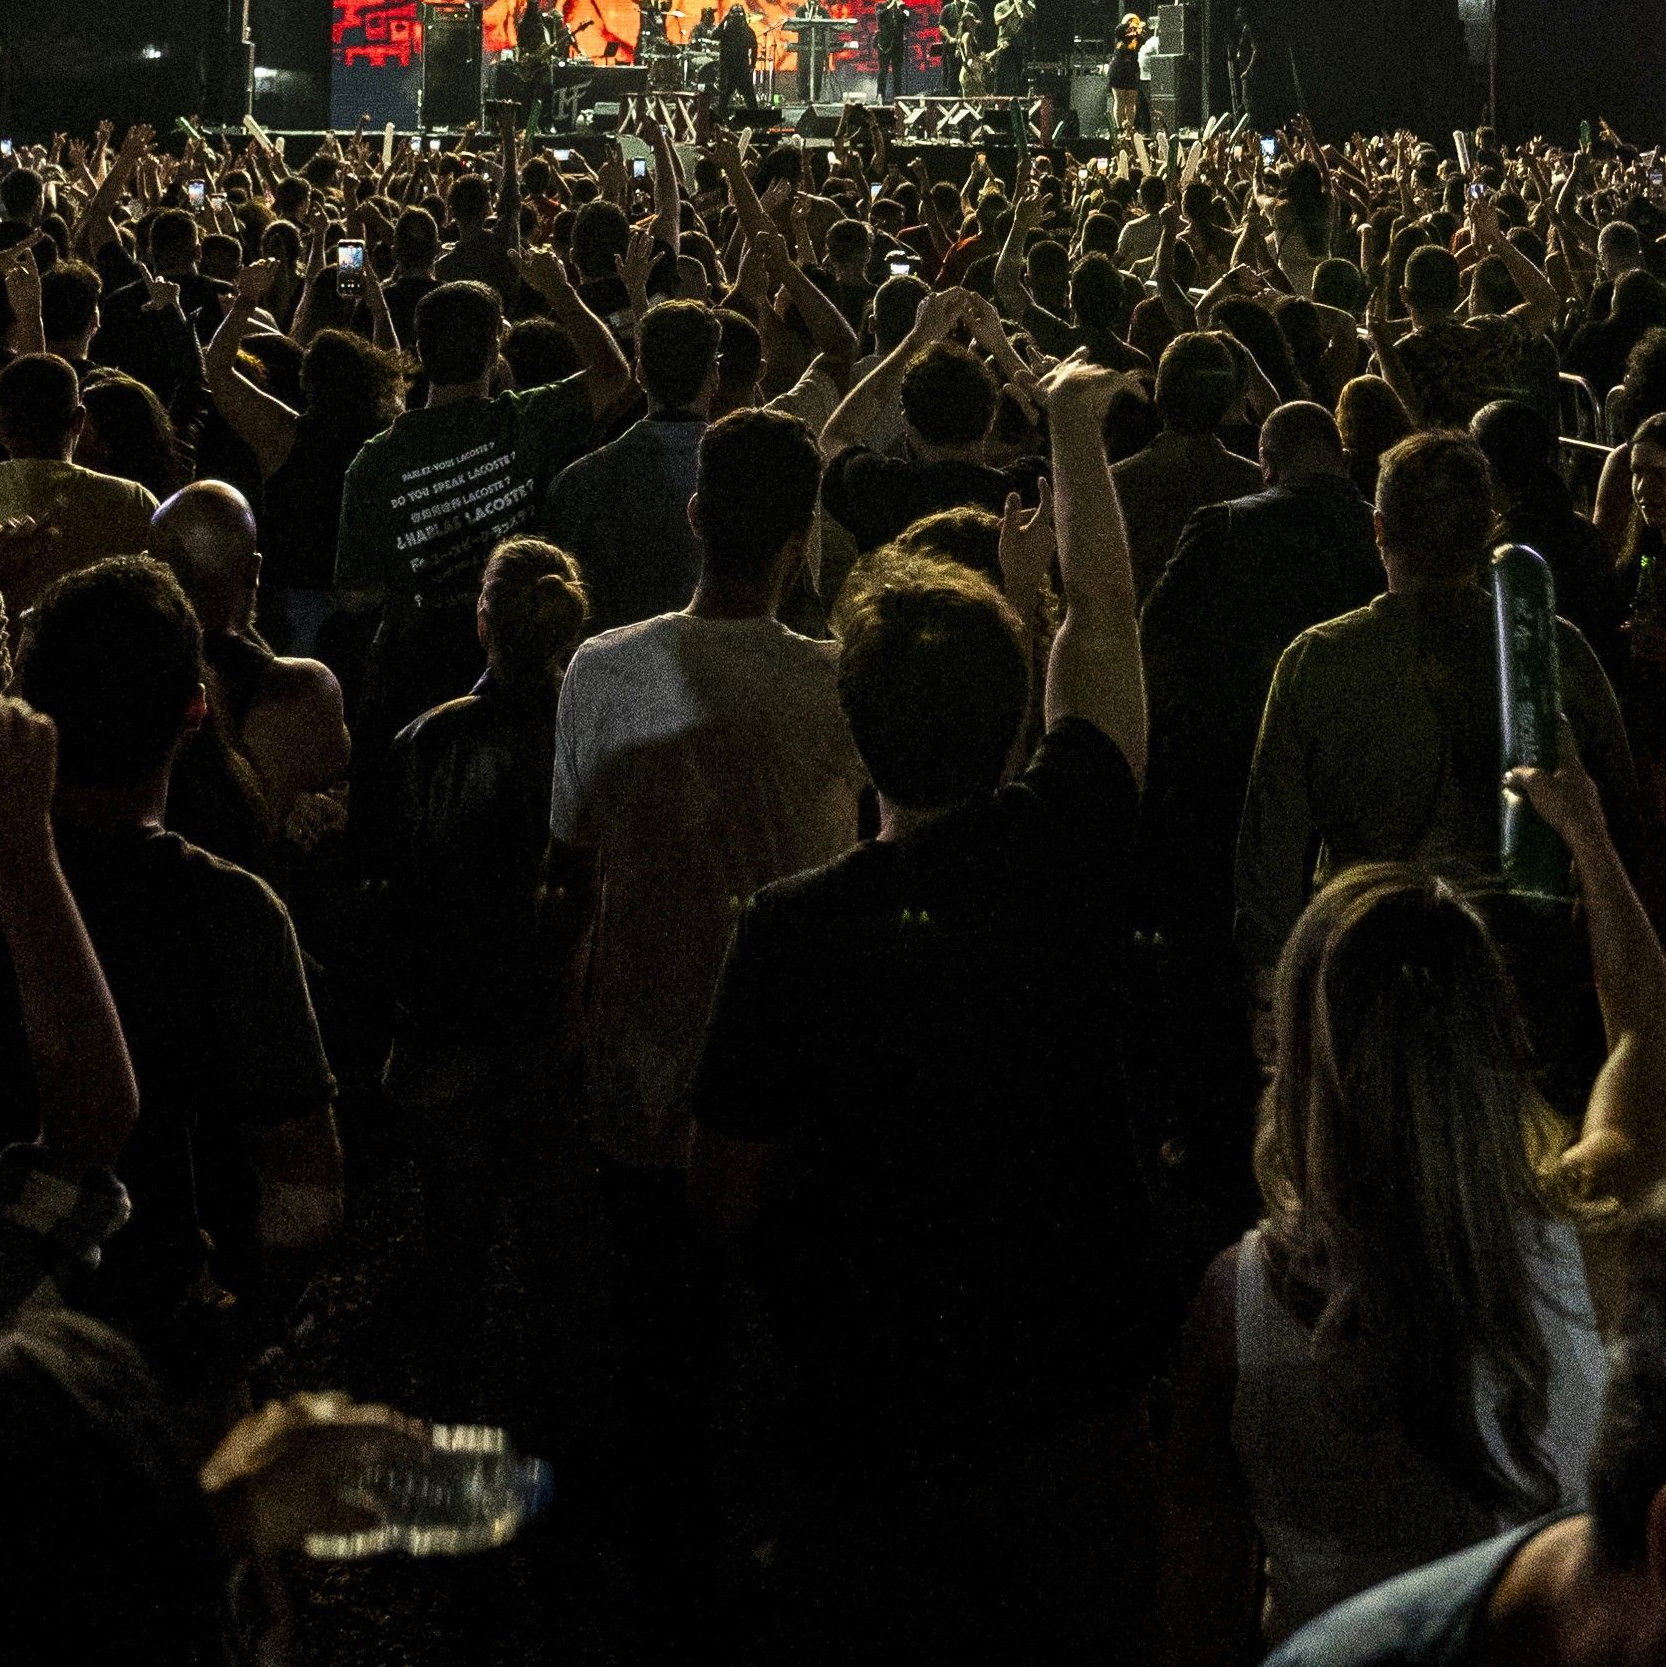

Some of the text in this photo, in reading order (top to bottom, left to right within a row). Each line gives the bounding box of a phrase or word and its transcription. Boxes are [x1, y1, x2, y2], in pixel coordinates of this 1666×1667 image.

[390, 495, 406, 509] DO
[407, 486, 430, 502] YOU
[432, 474, 466, 494] SPEAK
